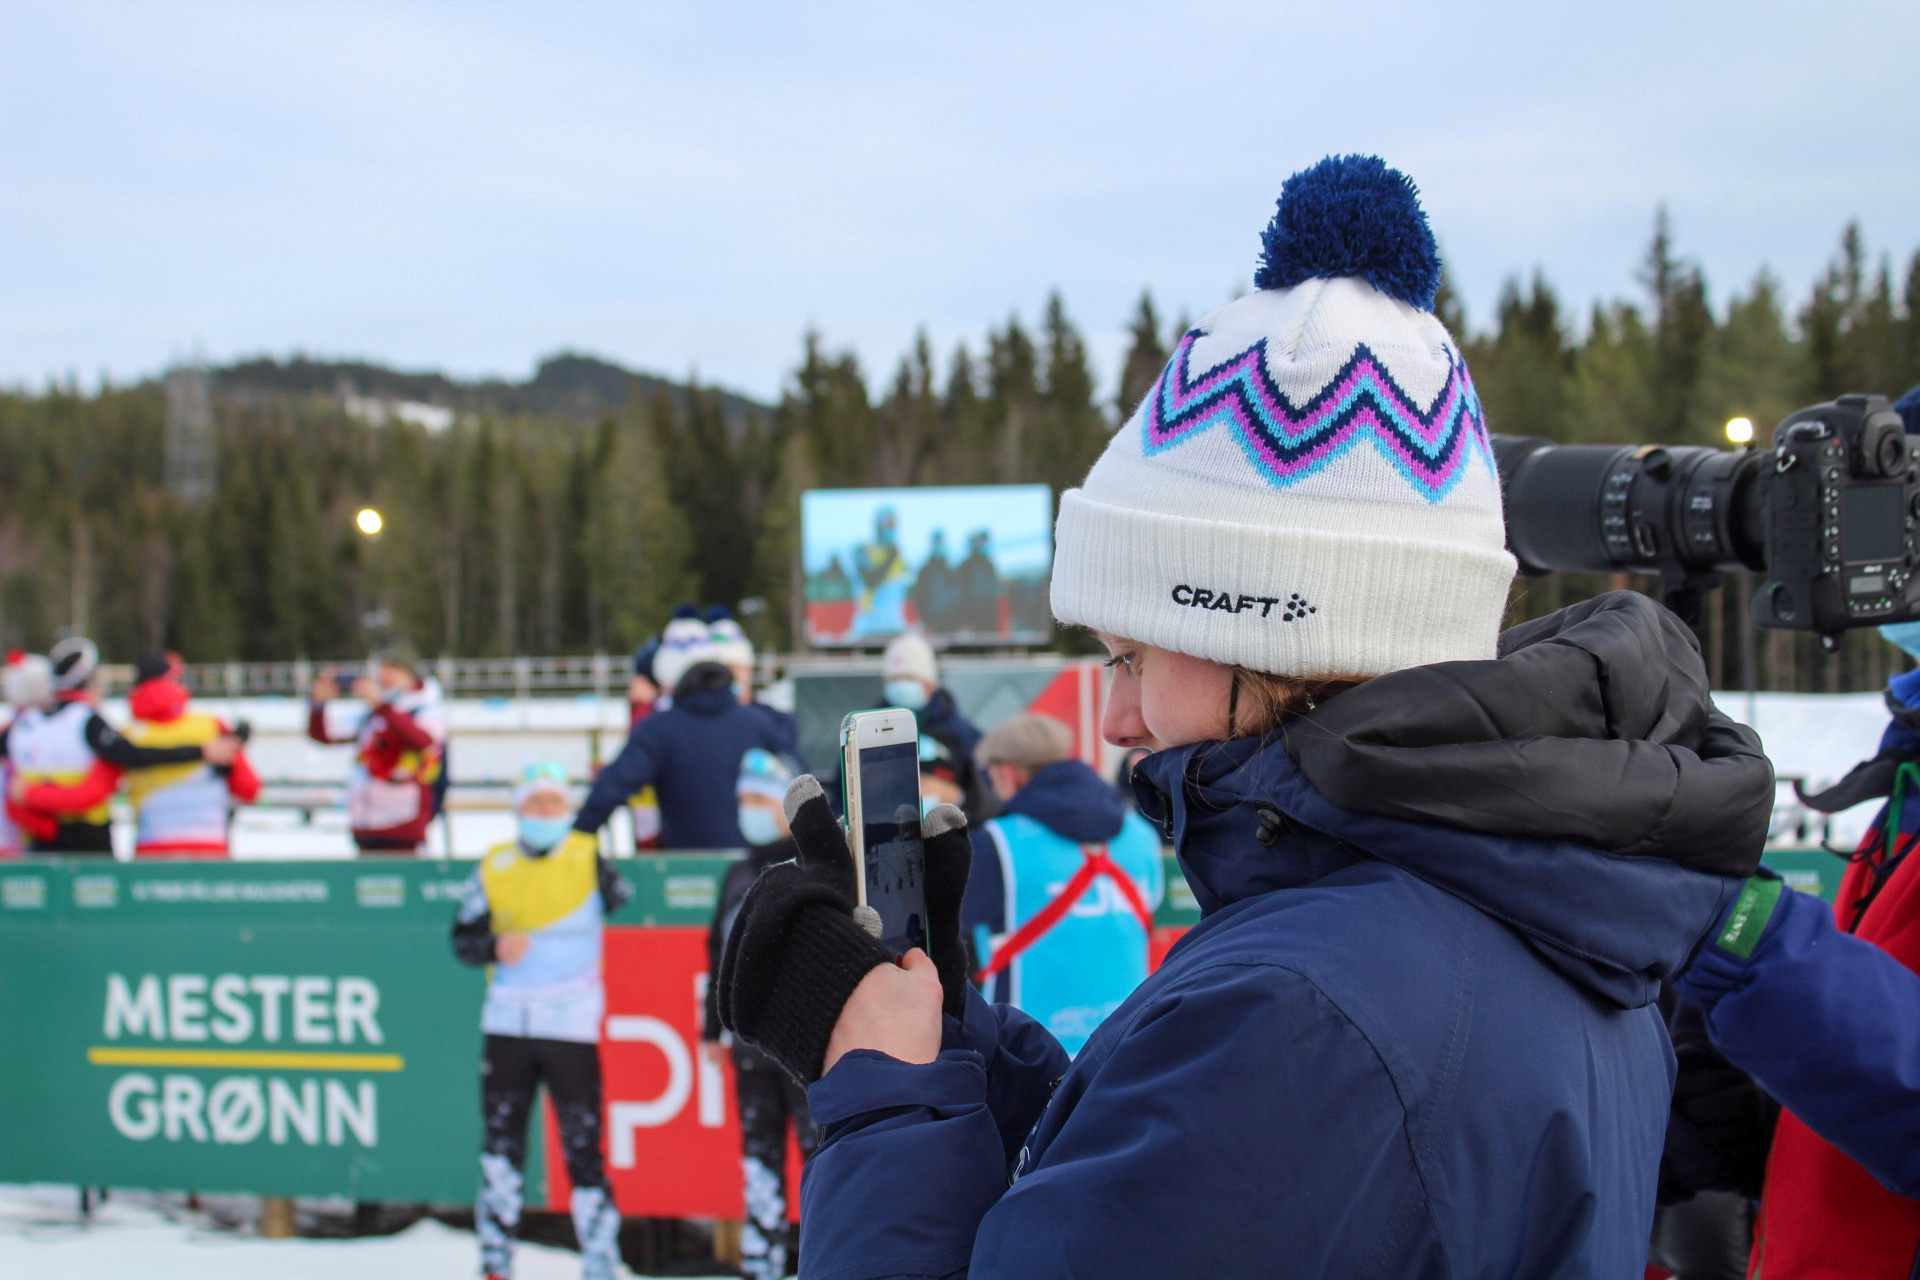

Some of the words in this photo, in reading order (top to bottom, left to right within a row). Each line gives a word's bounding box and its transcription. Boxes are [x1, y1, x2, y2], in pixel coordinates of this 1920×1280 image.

[1171, 584, 1280, 618] CRAFT
[103, 974, 383, 1044] MESTER
[108, 1073, 379, 1147] GRØNN
